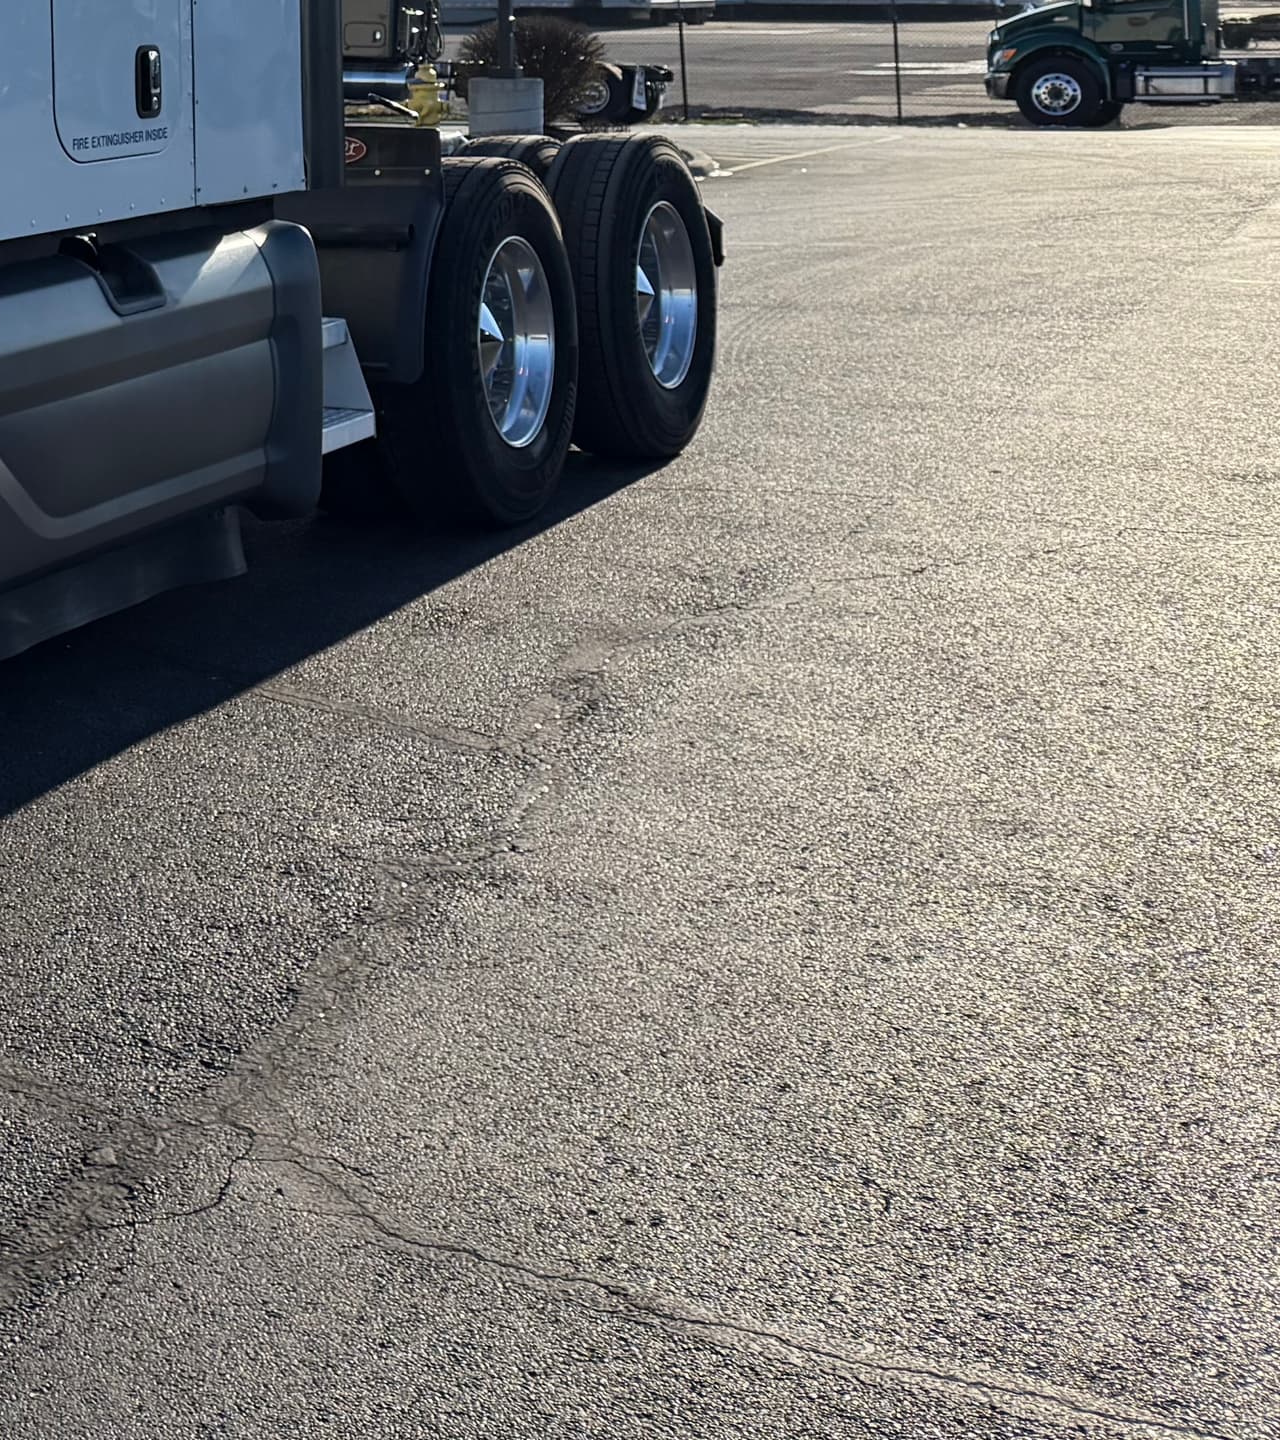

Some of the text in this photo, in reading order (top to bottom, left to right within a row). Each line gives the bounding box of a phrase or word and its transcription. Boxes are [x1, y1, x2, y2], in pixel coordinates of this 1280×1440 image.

[72, 127, 168, 151] FIRE EXTINGUISHER INSIDE
